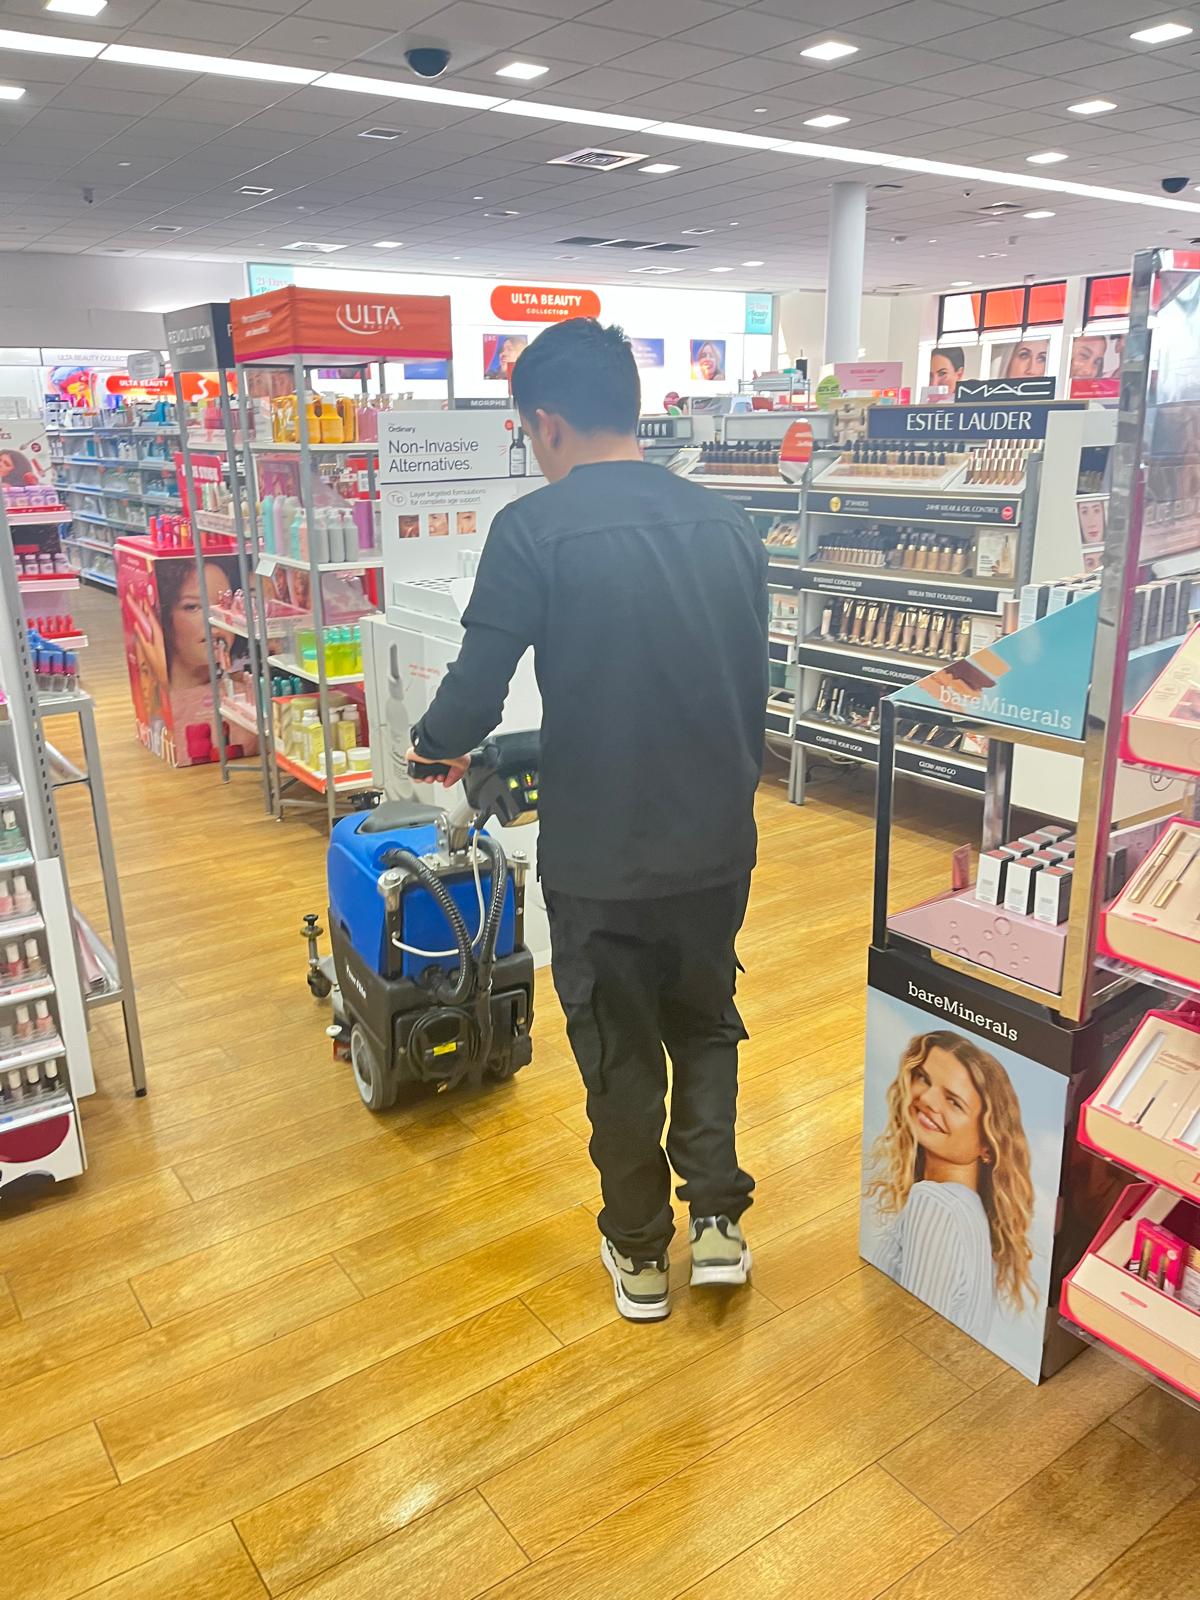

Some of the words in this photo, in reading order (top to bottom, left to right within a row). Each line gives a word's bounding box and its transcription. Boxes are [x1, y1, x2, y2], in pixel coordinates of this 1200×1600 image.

[511, 293, 537, 305] ULTA
[540, 294, 582, 307] BEAUTY
[344, 303, 401, 326] ULTA
[526, 307, 569, 316] COLLECTION
[168, 323, 211, 345] REVOLUTION
[119, 379, 139, 388] ULTA
[959, 411, 1033, 431] LAUDER
[388, 438, 479, 455] Non-Invasive
[939, 685, 1073, 729] bareMinerals
[907, 981, 1018, 1042] bareMinerals
